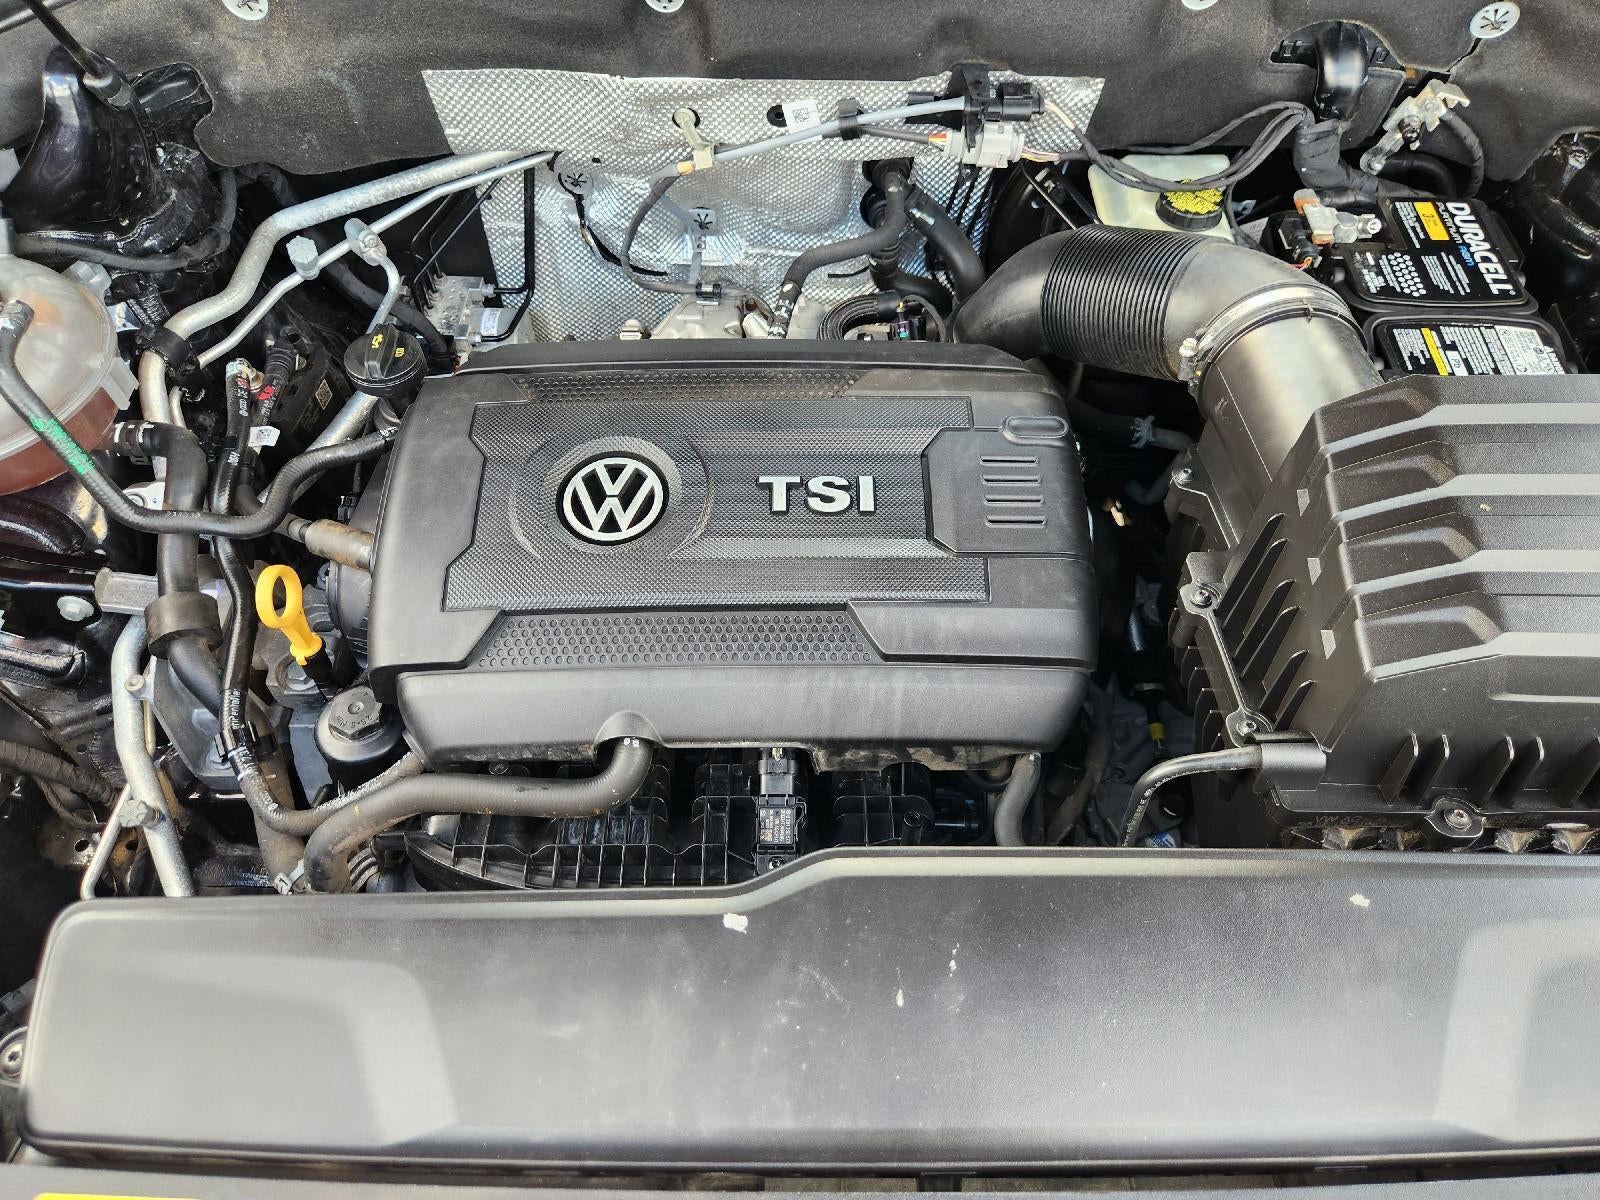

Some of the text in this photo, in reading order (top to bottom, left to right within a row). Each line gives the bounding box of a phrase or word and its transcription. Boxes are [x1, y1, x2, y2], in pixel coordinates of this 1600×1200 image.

[1436, 202, 1463, 244] PLATINUM
[1458, 245, 1476, 267] AGM
[1445, 202, 1514, 295] DURACELL
[1451, 358, 1462, 369] Pb
[757, 474, 875, 513] TSI
